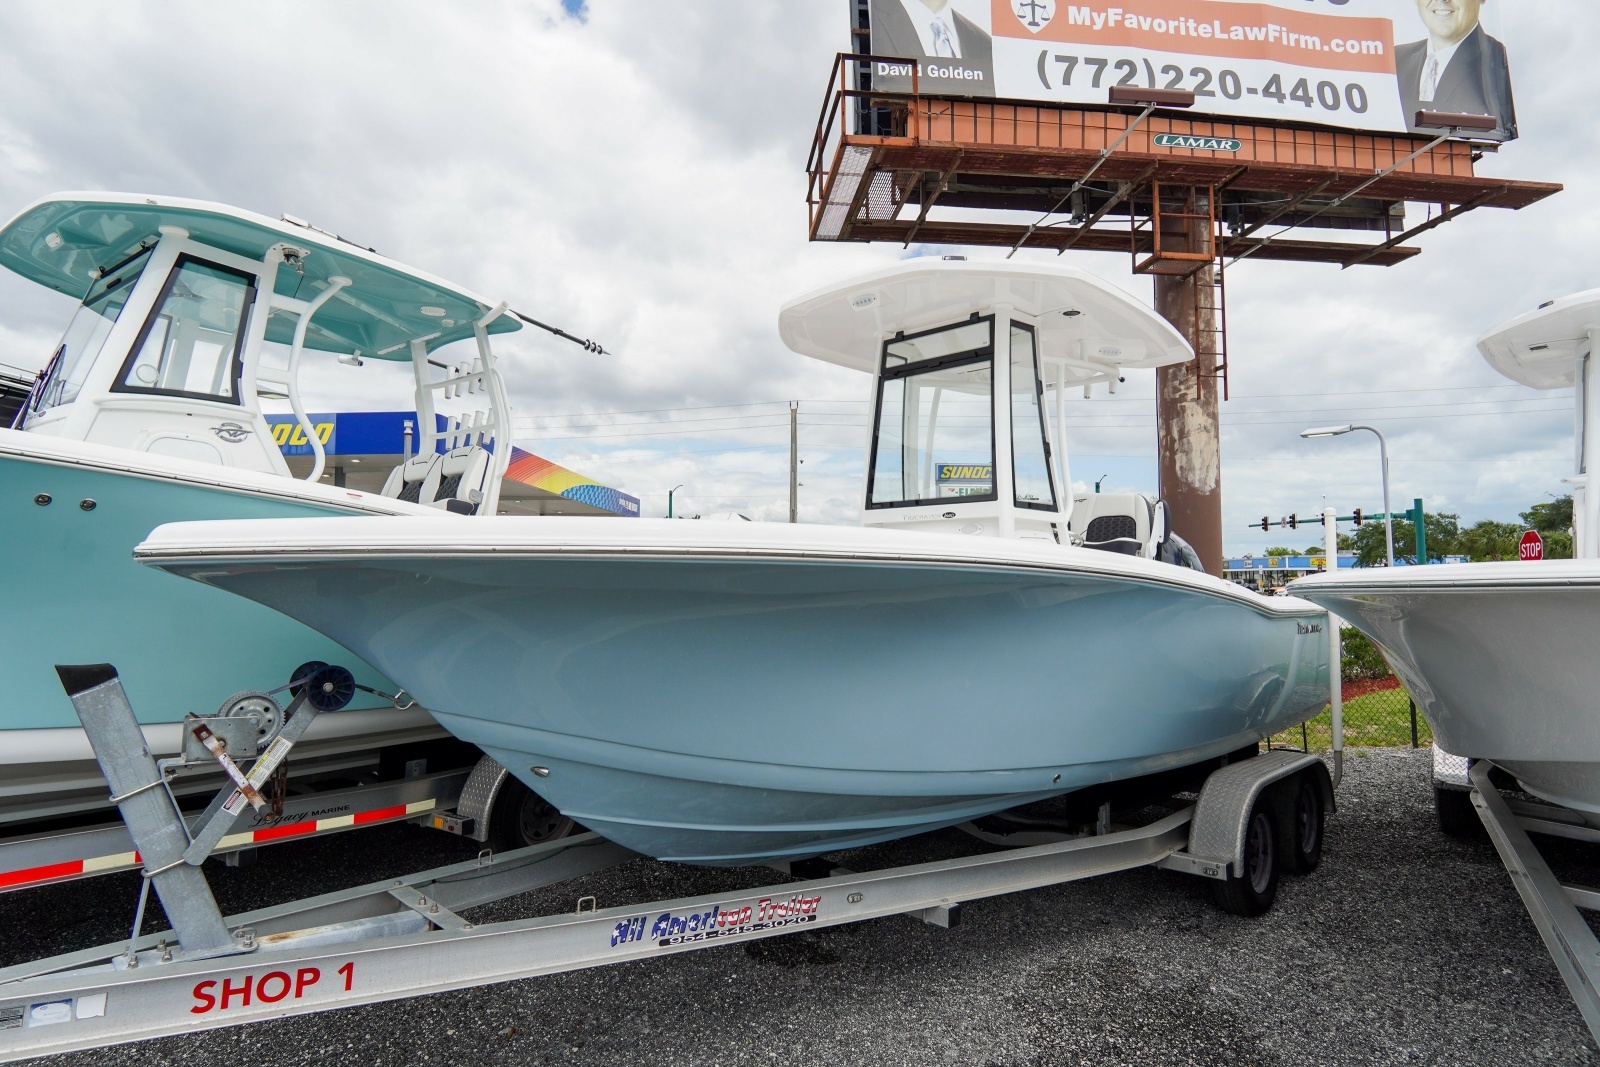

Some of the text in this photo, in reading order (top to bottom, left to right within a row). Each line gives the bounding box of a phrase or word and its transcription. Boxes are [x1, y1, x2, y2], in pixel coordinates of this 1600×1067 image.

[1068, 6, 1384, 55] MyFavoriteLawFirm.com
[878, 63, 984, 80] David Golden
[1036, 49, 1369, 113] (772)220-4400
[1161, 135, 1233, 149] LAMAR
[267, 423, 335, 446] OCO
[941, 466, 992, 479] SUNOC
[1521, 542, 1541, 558] STOP
[248, 804, 351, 828] Lgacy MARINE
[611, 895, 821, 947] All American Trailer
[669, 915, 809, 945] 954-545-3020
[190, 961, 354, 1014] SHOP 1
